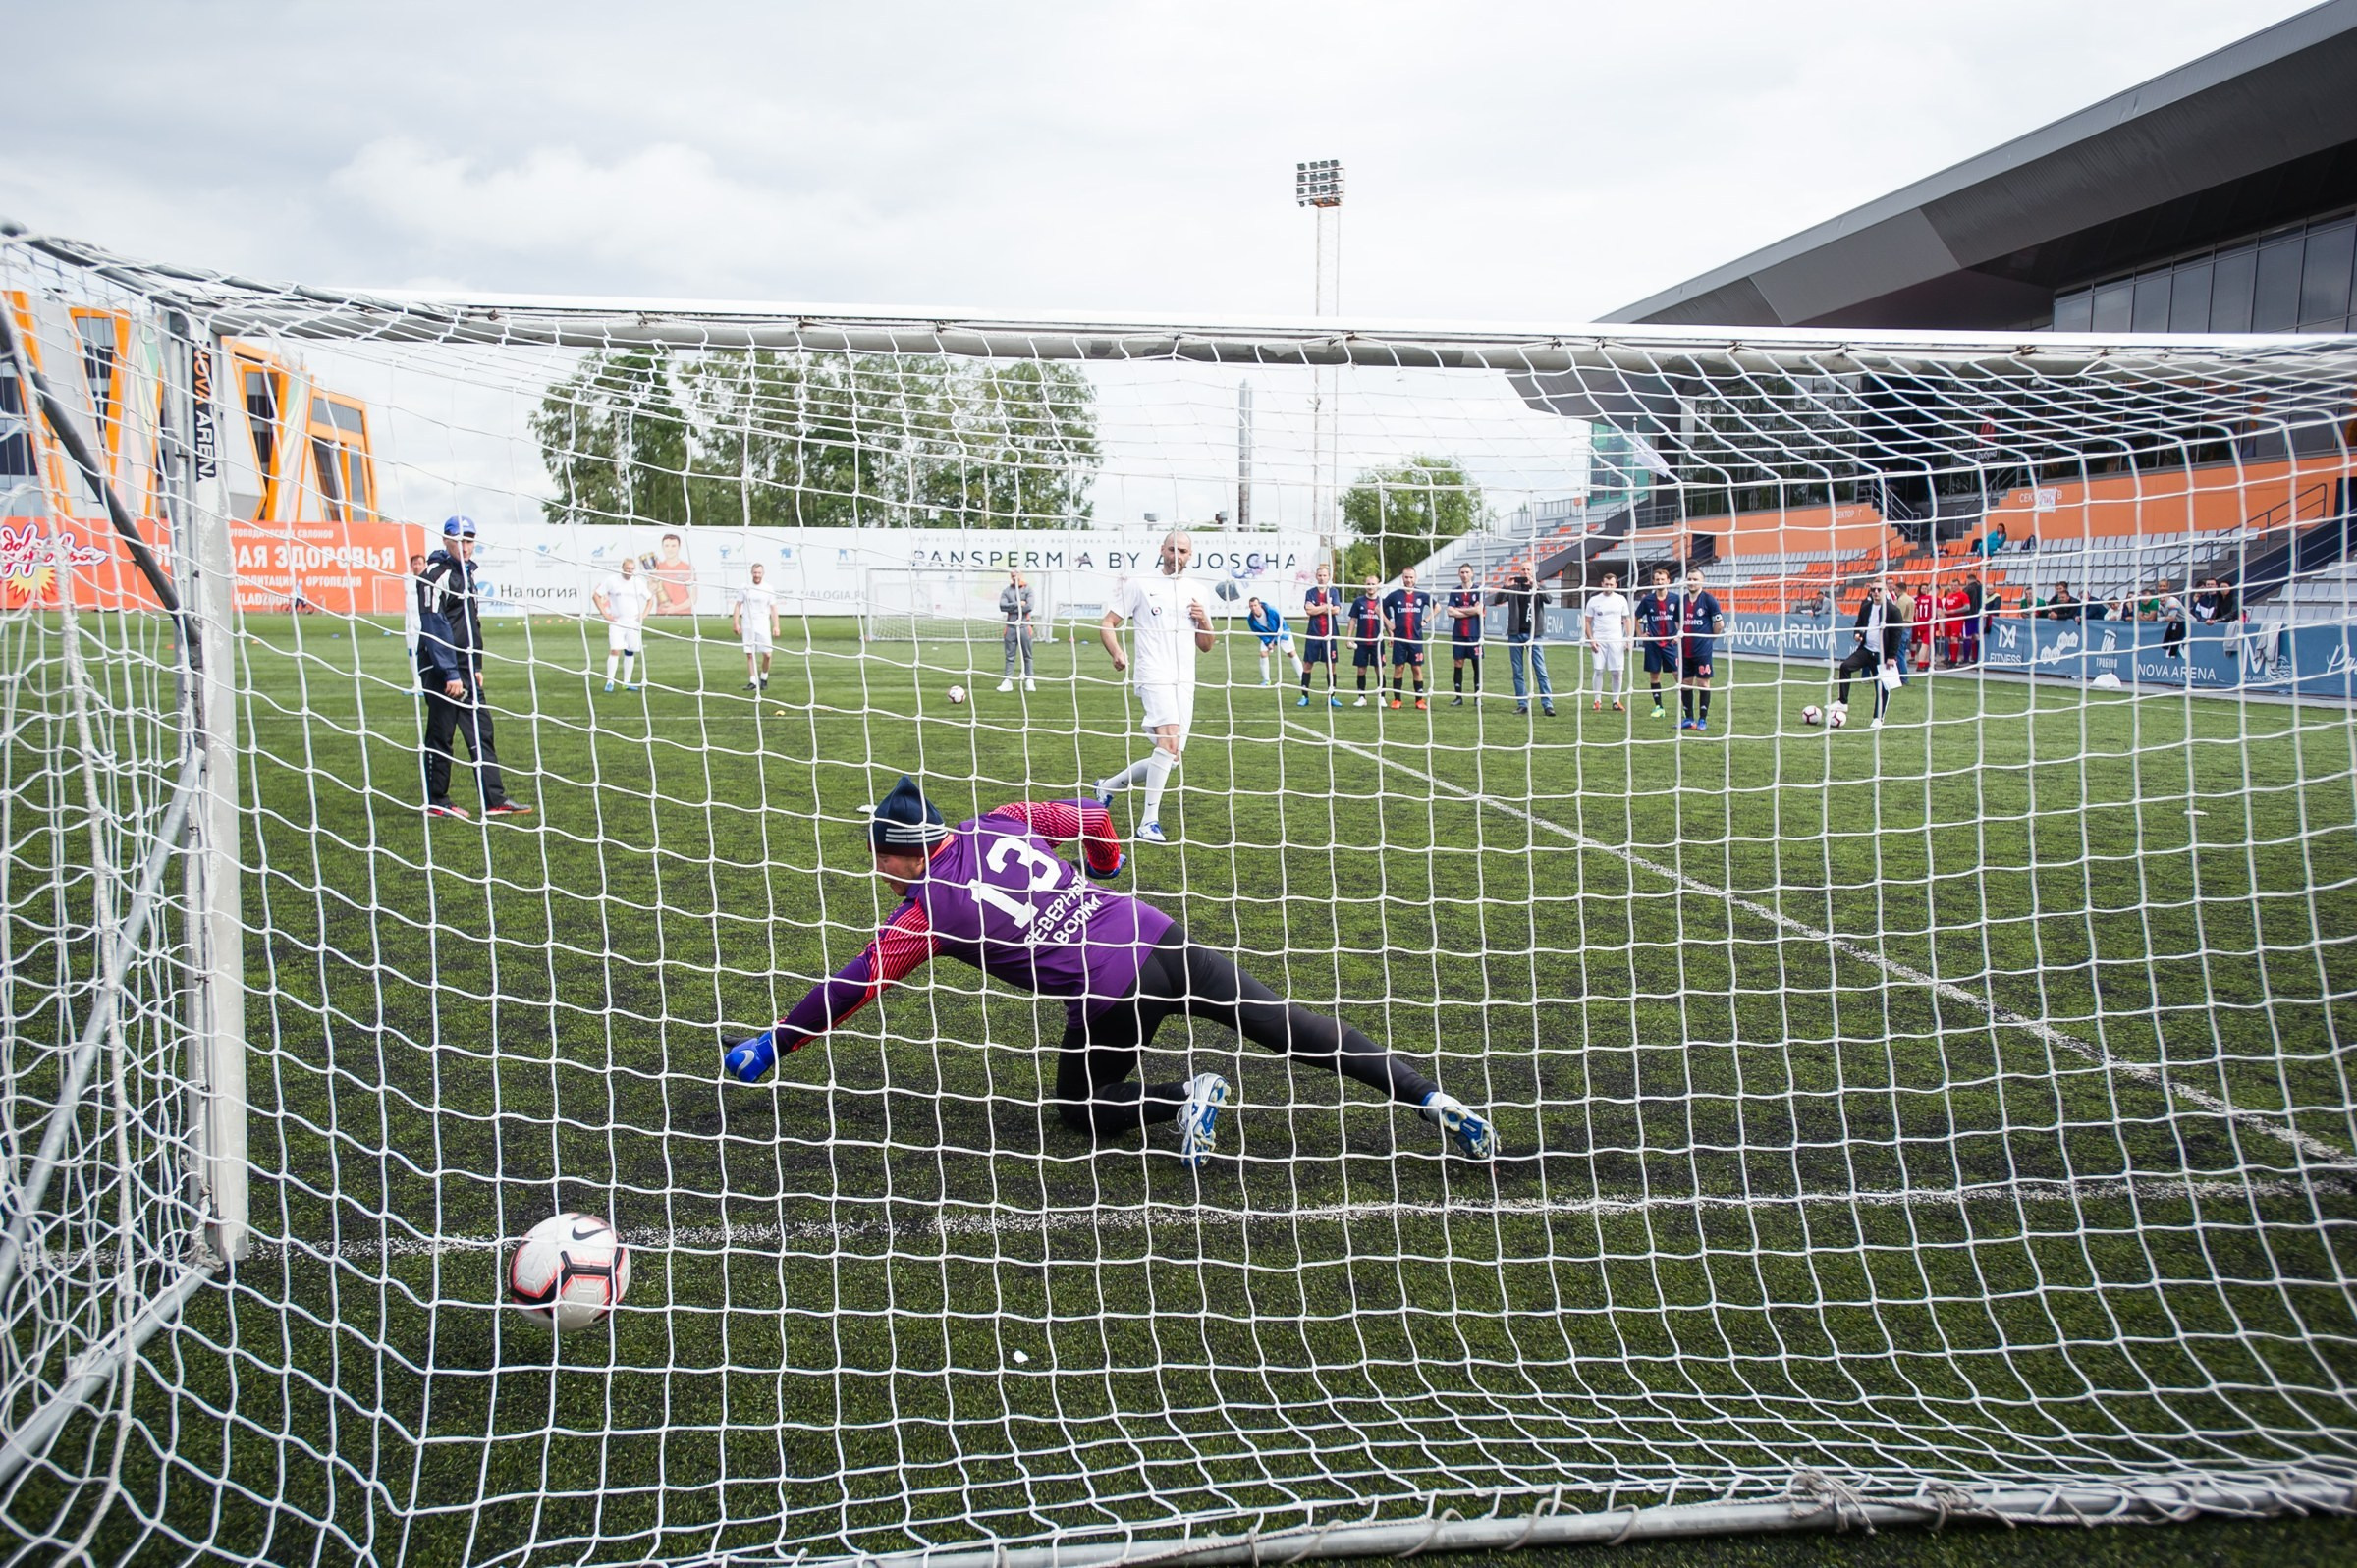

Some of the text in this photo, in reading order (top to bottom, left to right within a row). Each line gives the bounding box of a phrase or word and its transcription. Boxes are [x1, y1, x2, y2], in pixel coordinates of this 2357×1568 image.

[274, 545, 395, 572] ЗДОРОВЬЯ
[1109, 552, 1141, 568] BY
[1155, 552, 1296, 569] AJOSCHA
[500, 583, 577, 599] Налогия
[1919, 604, 1929, 618] 11
[1989, 652, 2022, 664] FITNESS
[2138, 663, 2217, 681] NOVA ARENA
[967, 837, 1062, 929] 13
